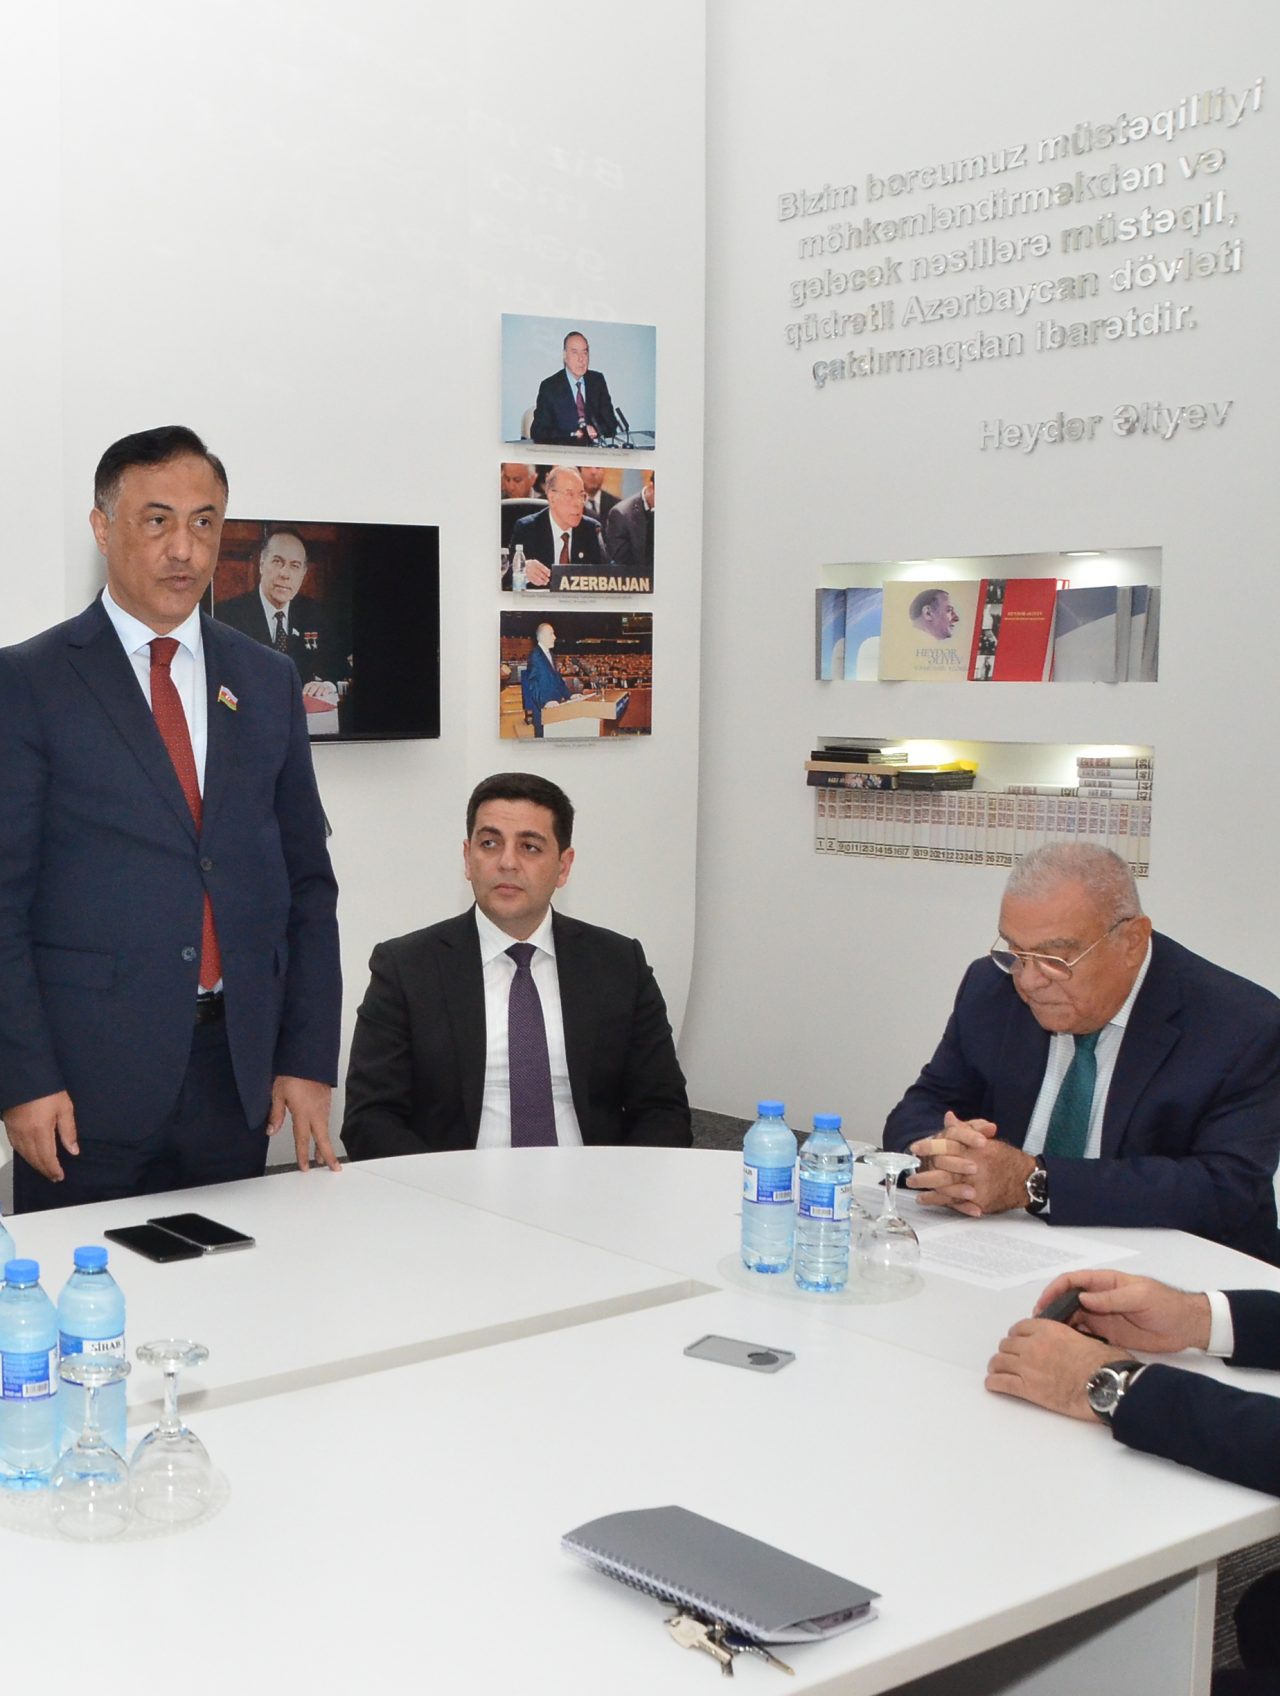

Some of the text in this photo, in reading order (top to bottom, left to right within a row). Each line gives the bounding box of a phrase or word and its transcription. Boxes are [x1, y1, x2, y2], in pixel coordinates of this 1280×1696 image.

[777, 76, 1266, 222] Bizim borcumuz müstəqilliyi
[798, 147, 1227, 260] möhkəmləndirməkdən və
[783, 238, 1244, 352] qüdrətli Azərbaycan dövləti
[789, 189, 1239, 309] gələcək nəsillərə müstəqil,
[811, 300, 1198, 389] çatdırmaqdan ibarətdir.
[980, 400, 1234, 454] Heydər Əliyev
[559, 575, 650, 592] AZERBAIJAN
